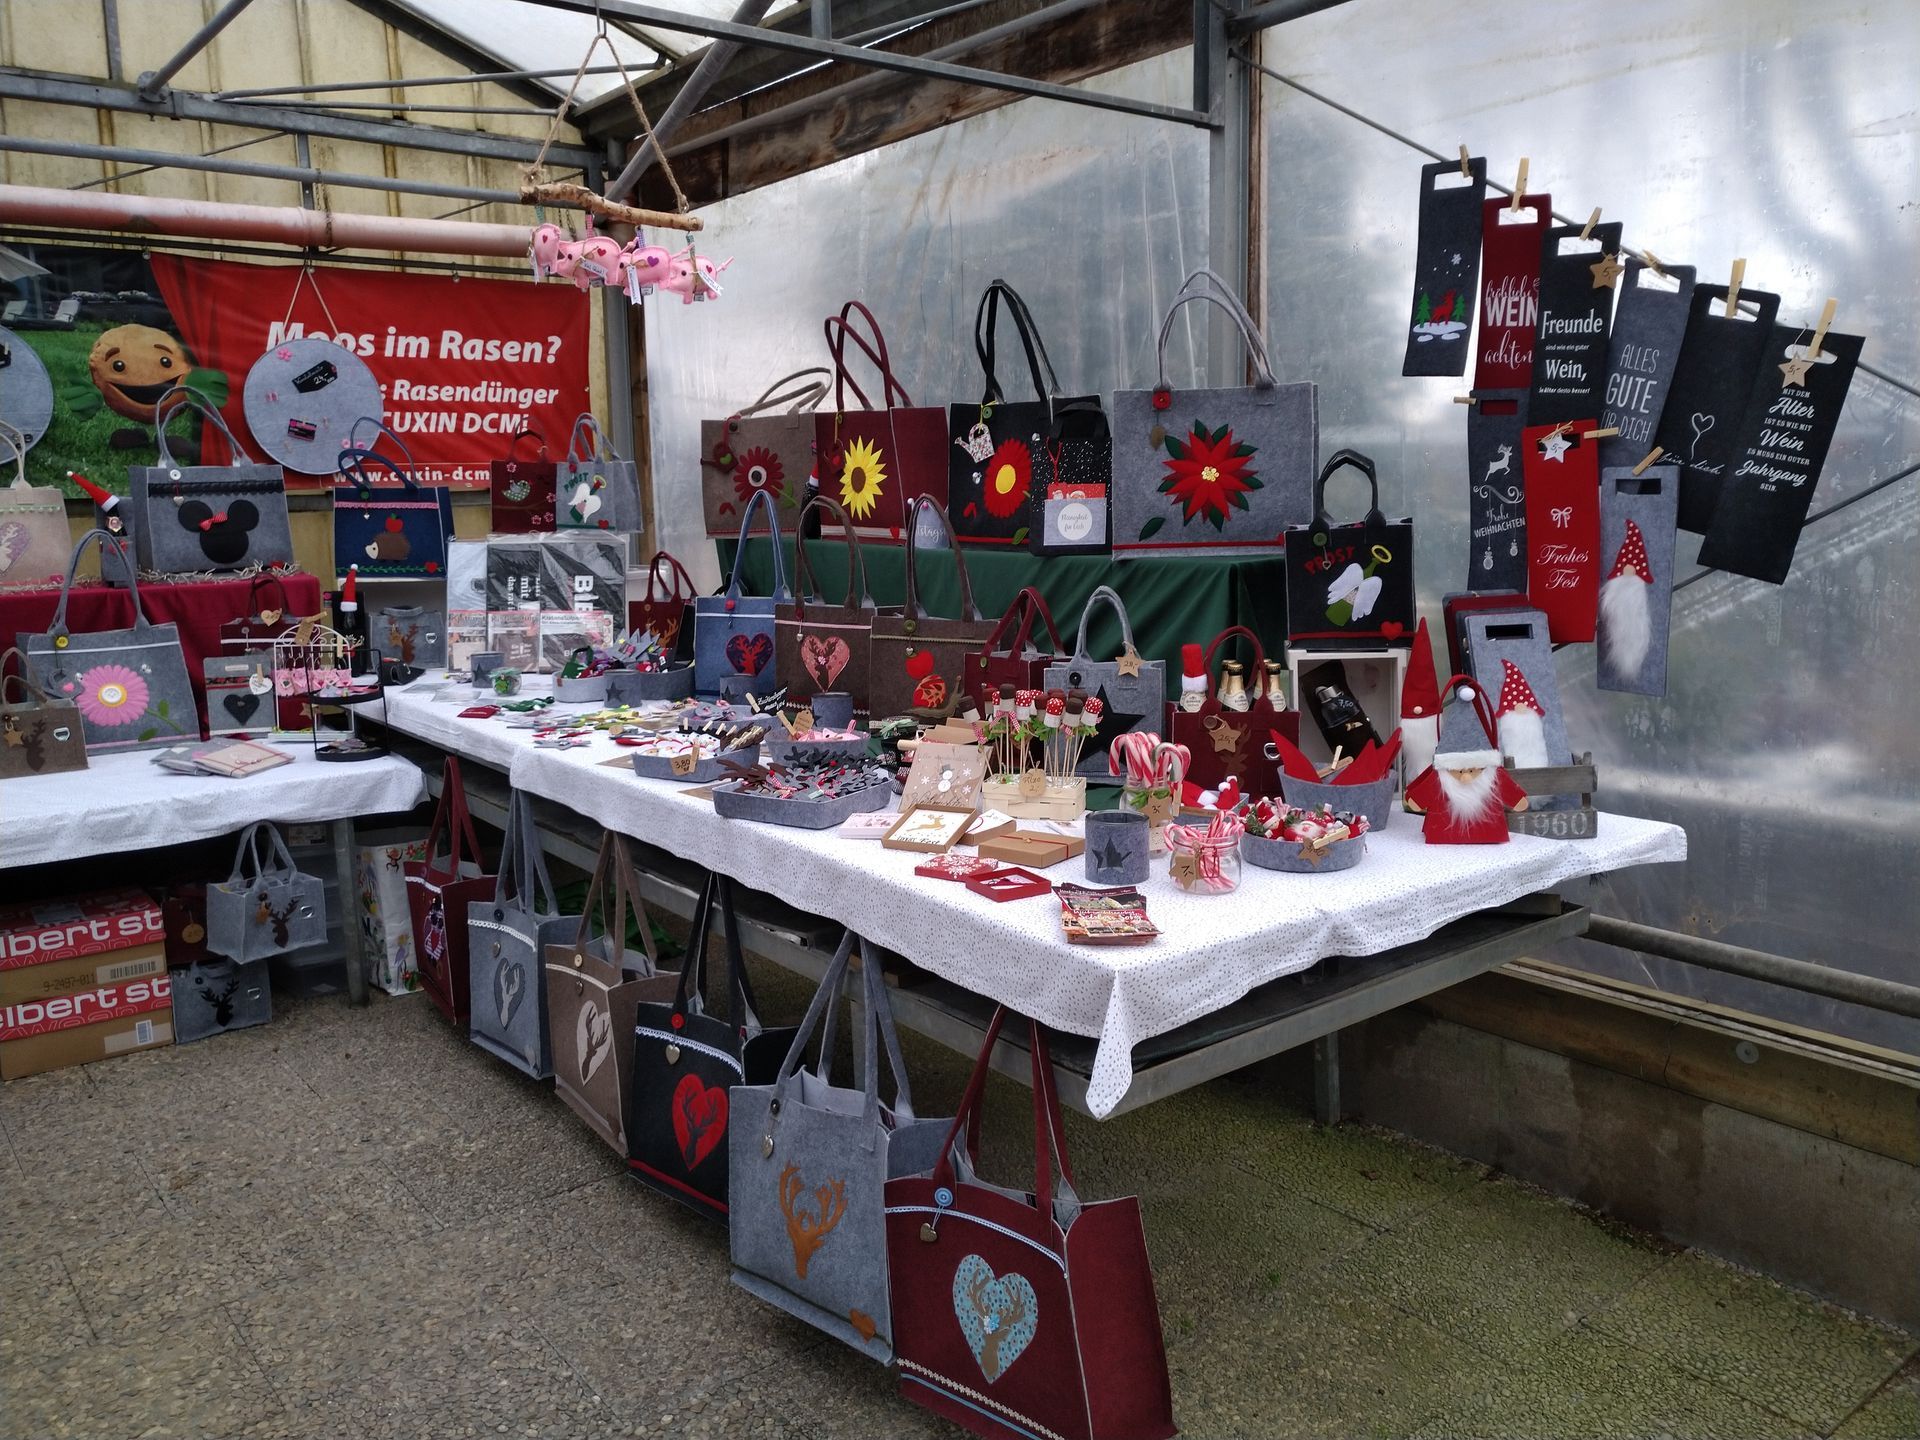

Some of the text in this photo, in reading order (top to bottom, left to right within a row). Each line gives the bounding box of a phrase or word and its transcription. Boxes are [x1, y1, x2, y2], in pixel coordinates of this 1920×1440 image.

[1485, 296, 1538, 327] WEIN
[1541, 308, 1603, 340] Freunde
[384, 326, 431, 357] im
[440, 330, 562, 363] Rasen?
[1484, 329, 1533, 370] achten
[1545, 359, 1588, 381] Wein,
[1620, 344, 1660, 373] ALLES
[393, 379, 559, 409] Rasendünger
[1606, 373, 1658, 414] GUTE
[1782, 388, 1811, 398] MIT DEM
[1769, 397, 1815, 419] Alter
[381, 411, 457, 433] CUXIN
[1618, 415, 1652, 443] DICH
[1764, 417, 1813, 432] IST ES WIE MIT
[1760, 428, 1804, 452] Wein
[1689, 459, 1725, 475] dich
[1747, 447, 1810, 466] ES MUSS EIN GUTER
[1735, 459, 1808, 487] Jahrgang
[1760, 483, 1777, 492] SEIN.
[1473, 517, 1526, 538] WEIHNACHTEN
[1536, 544, 1590, 566] Frohes
[1545, 568, 1581, 590] Fest
[1516, 812, 1588, 837] 1960
